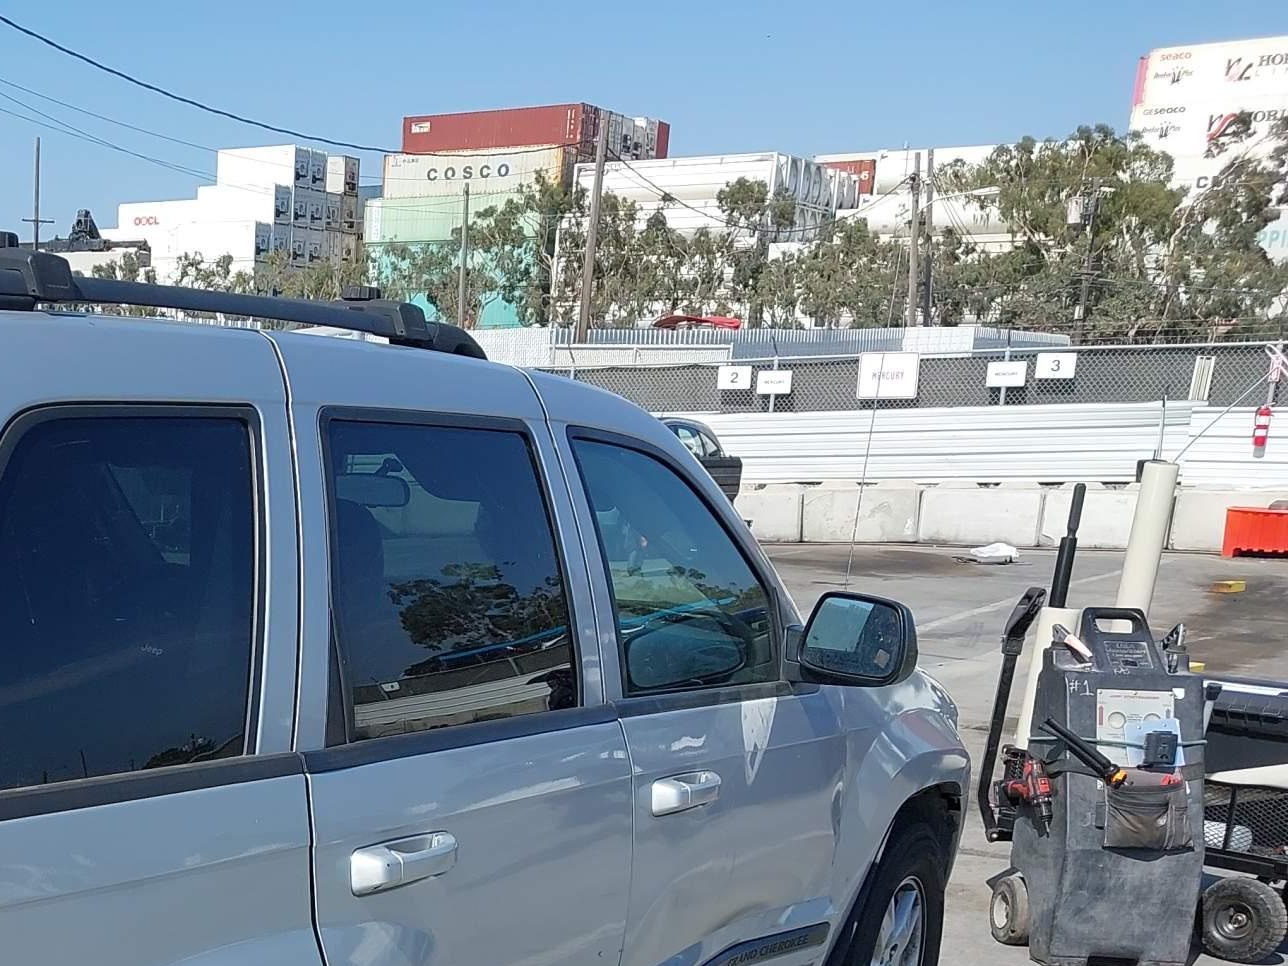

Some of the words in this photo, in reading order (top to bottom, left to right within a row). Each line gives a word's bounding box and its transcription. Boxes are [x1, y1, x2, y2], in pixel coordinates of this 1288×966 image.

[426, 163, 511, 182] COSCO
[133, 216, 160, 226] OOCL
[1050, 359, 1061, 372] 3
[729, 371, 740, 384] 2
[1069, 680, 1095, 696] #1
[760, 934, 809, 956] CHEROKEE
